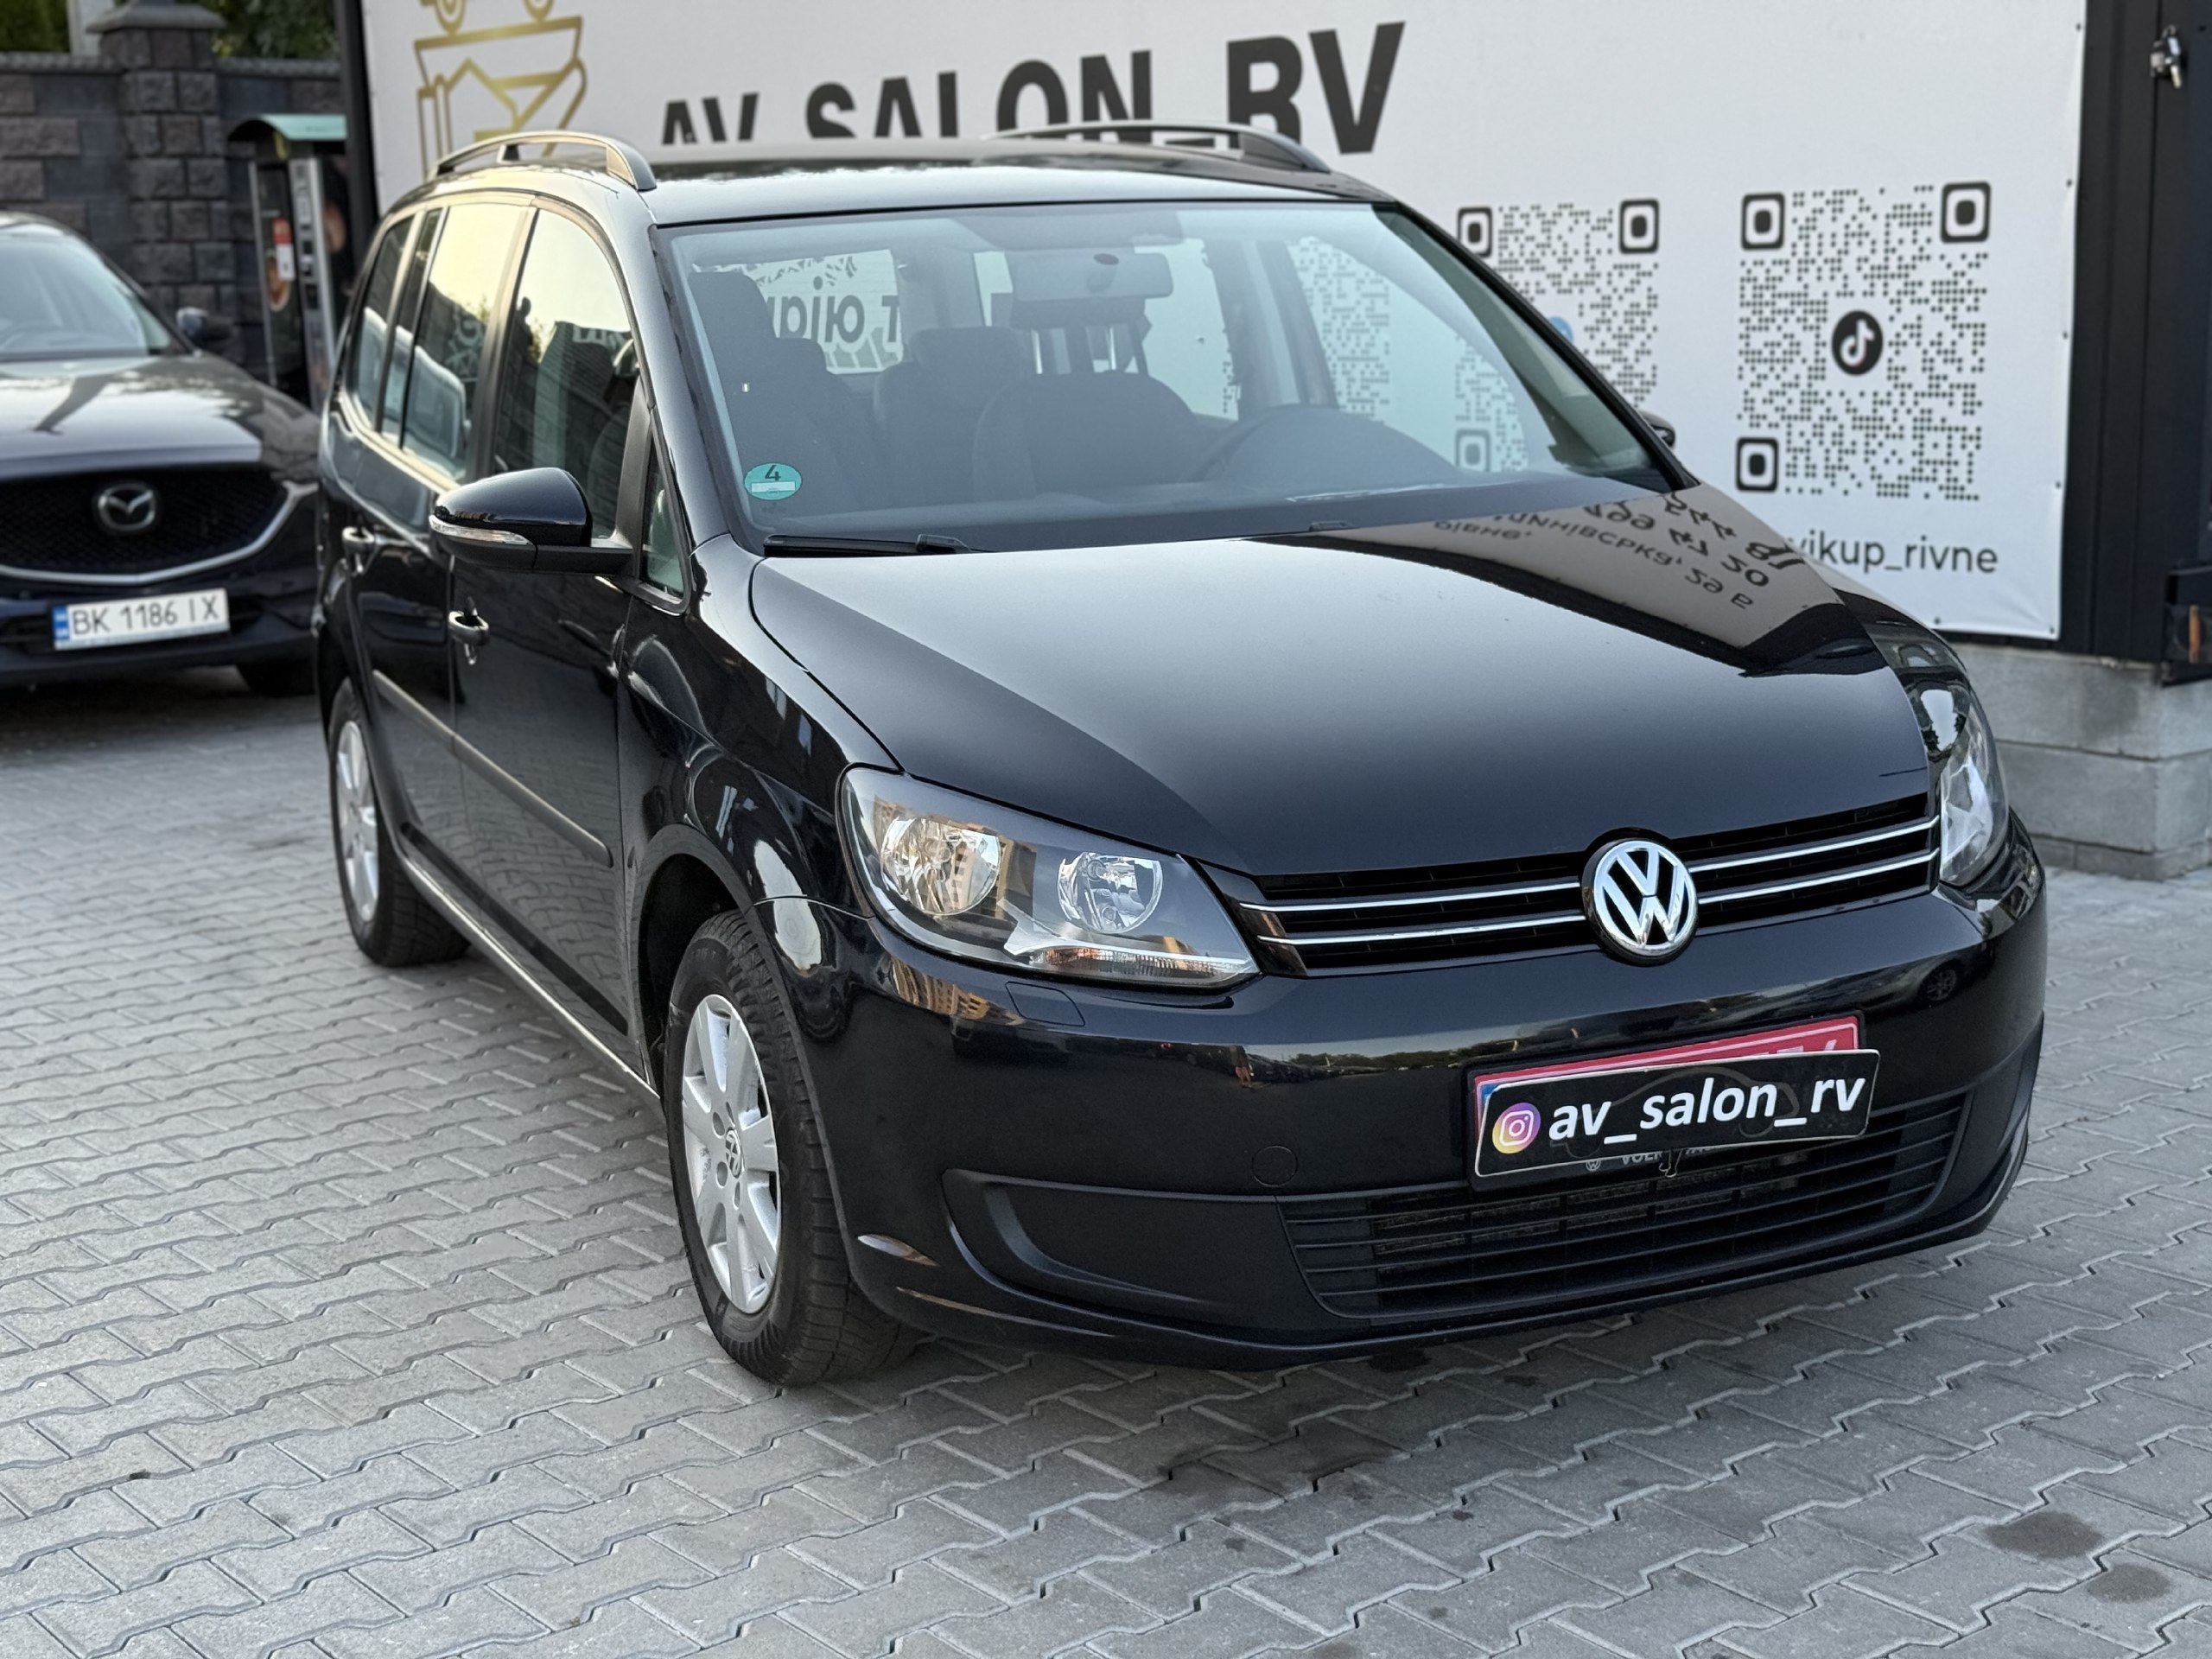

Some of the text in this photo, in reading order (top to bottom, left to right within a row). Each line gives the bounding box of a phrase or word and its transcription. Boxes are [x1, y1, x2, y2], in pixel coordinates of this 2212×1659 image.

[765, 464, 781, 481] 4
[73, 607, 110, 635] BK
[119, 601, 178, 630] 1186
[1549, 1077, 1866, 1145] av_salon_rv
